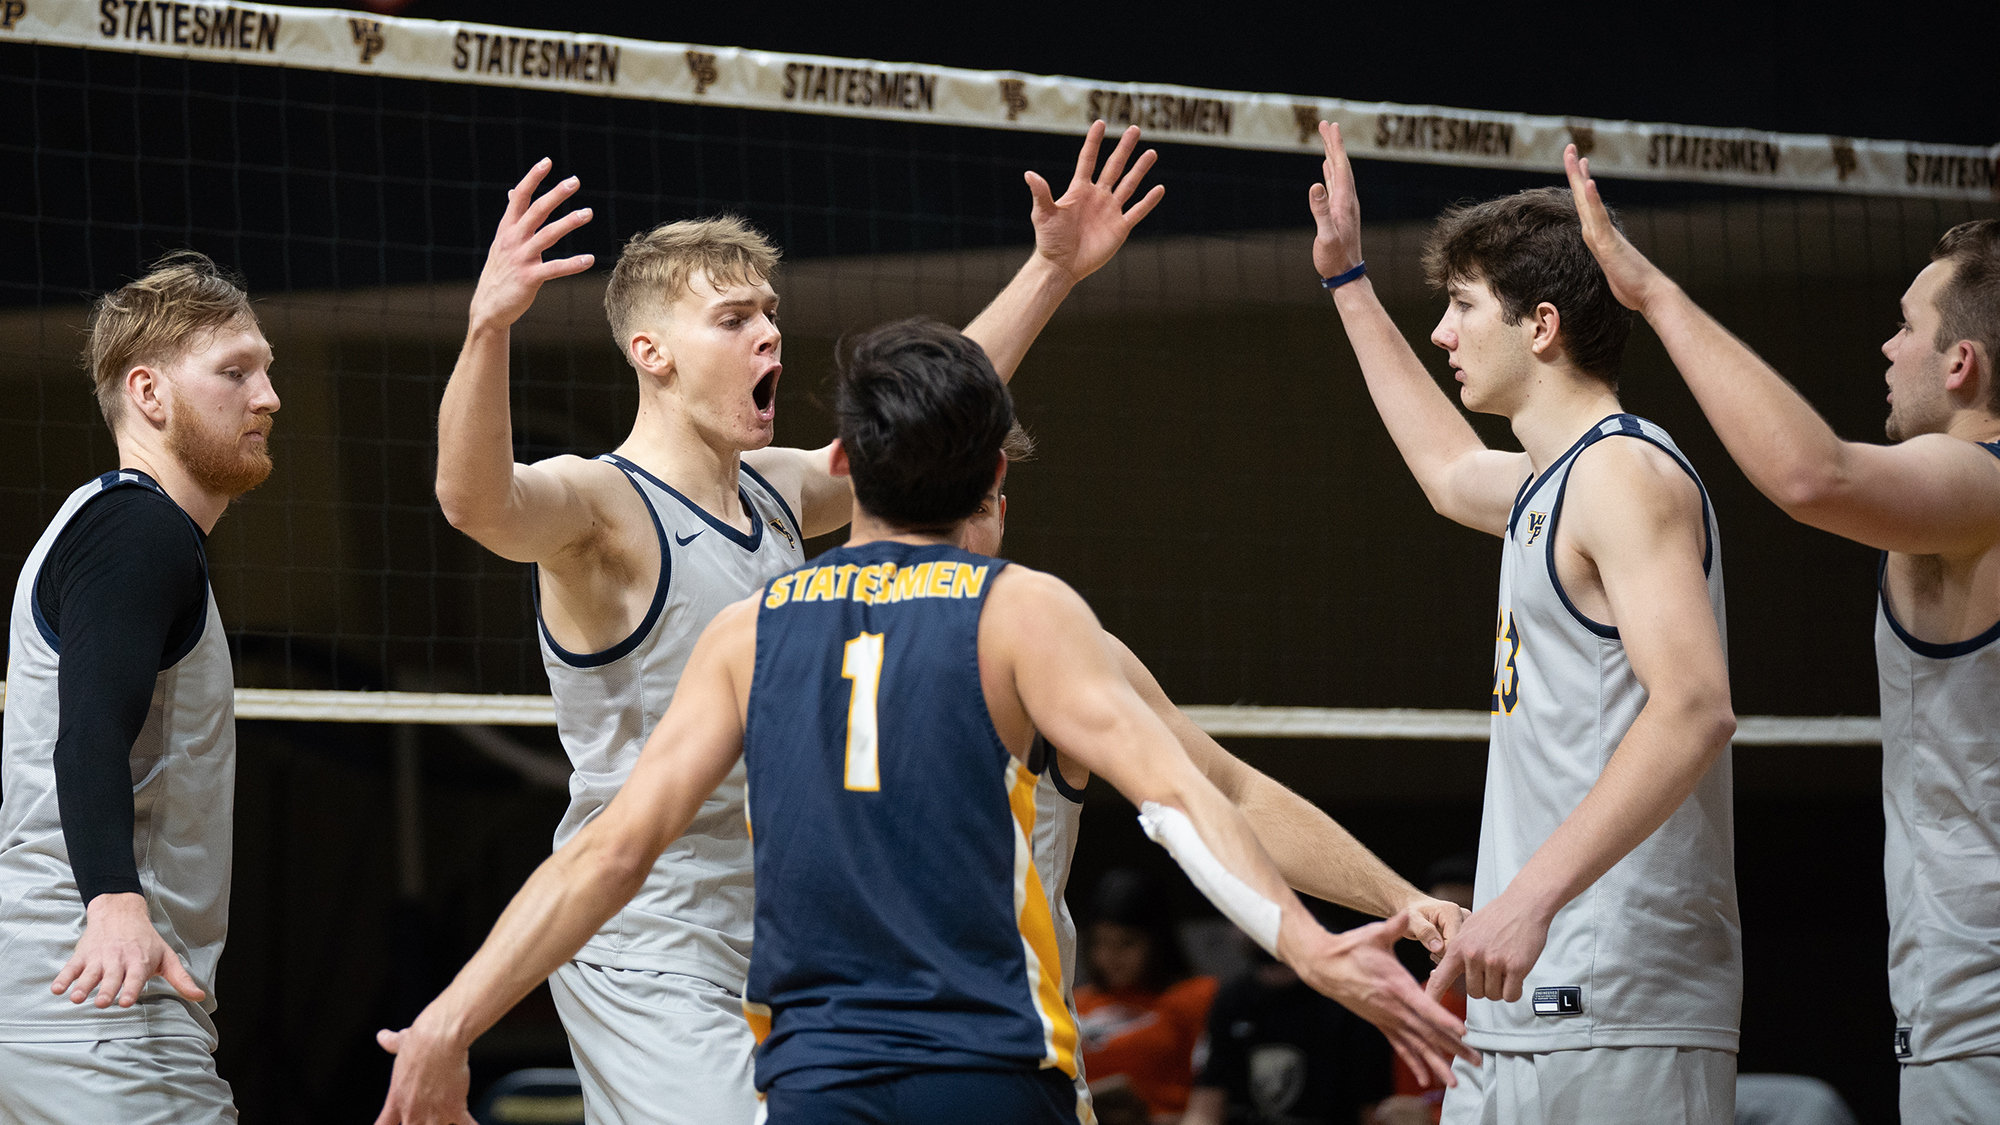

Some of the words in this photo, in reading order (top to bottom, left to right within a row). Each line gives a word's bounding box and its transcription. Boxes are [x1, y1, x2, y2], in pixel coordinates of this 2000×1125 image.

[99, 0, 281, 51] STATESMEN
[453, 29, 621, 84] STATESMEN
[783, 62, 936, 111] STATESMEN
[1087, 90, 1234, 136] STATESMEN
[1374, 112, 1515, 155] STATESMEN
[1648, 133, 1779, 174] STATESMEN
[1526, 510, 1547, 546] WP
[765, 561, 989, 609] STATESMEN
[841, 630, 885, 793] 1
[1564, 995, 1572, 1007] L
